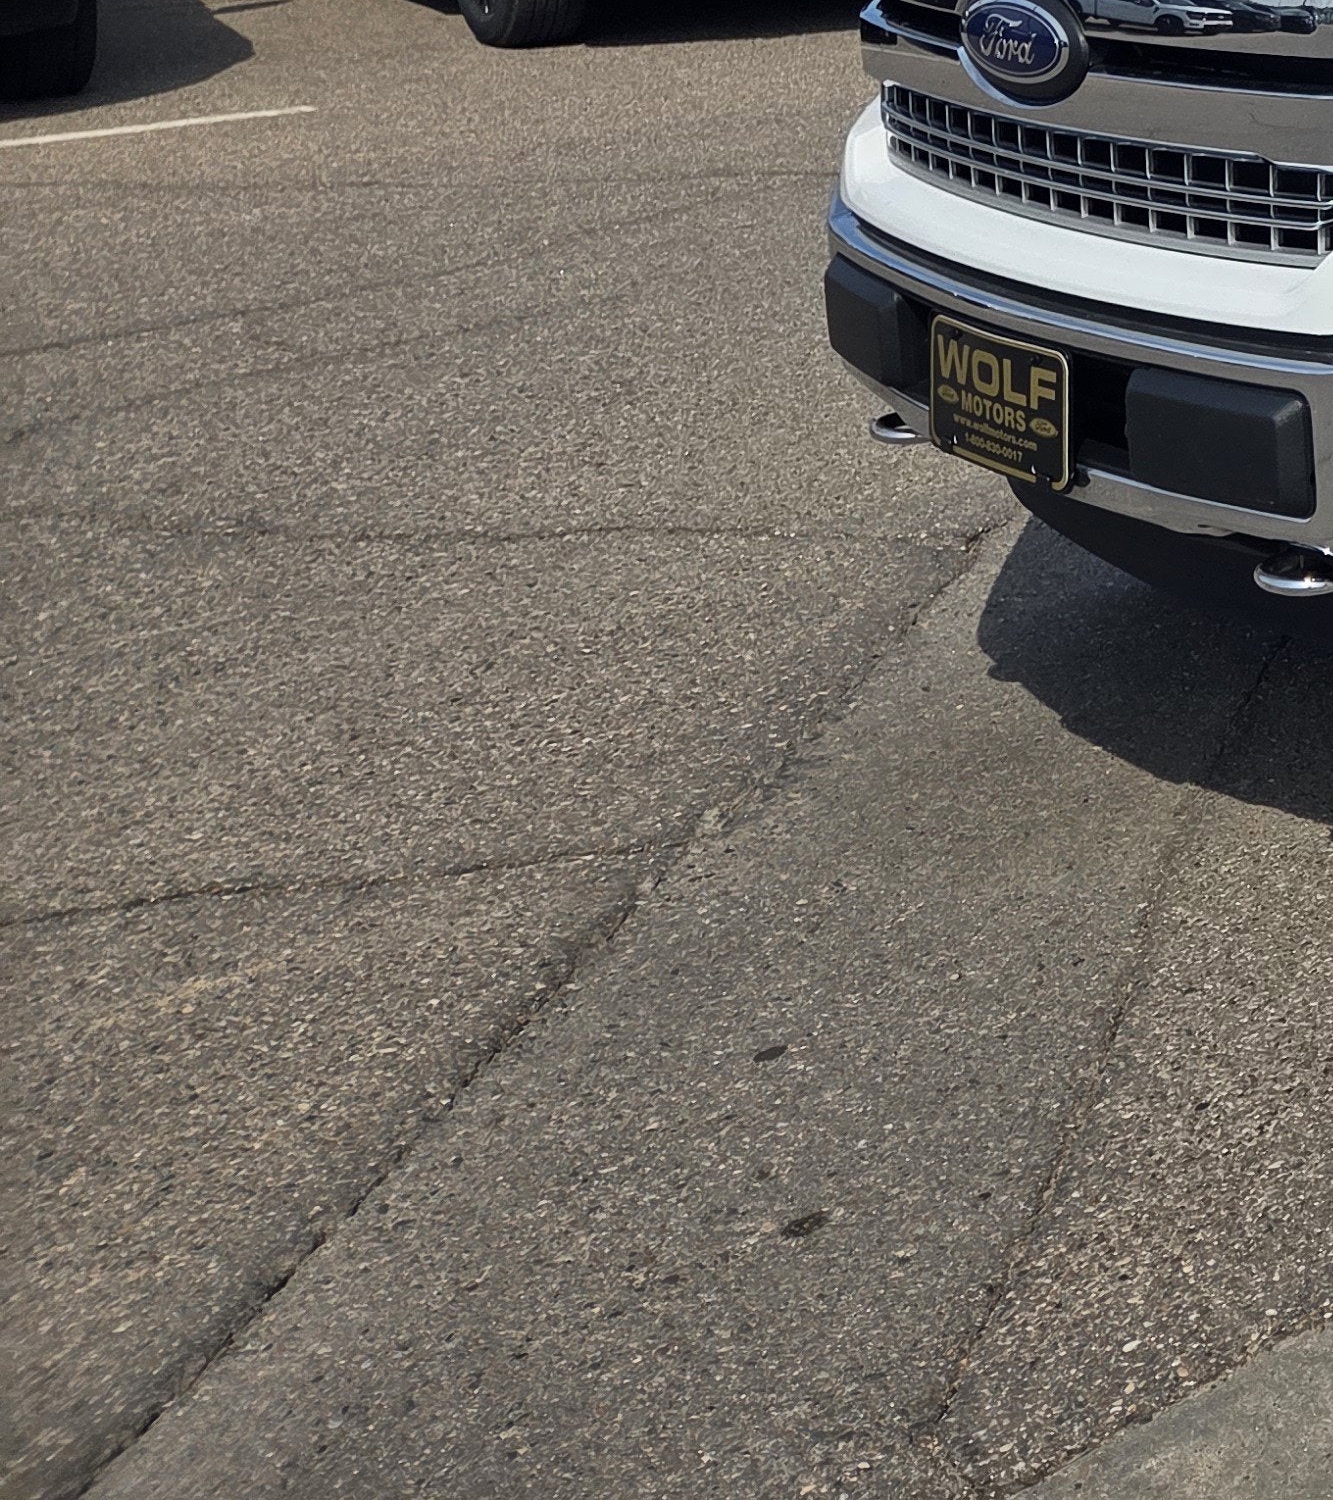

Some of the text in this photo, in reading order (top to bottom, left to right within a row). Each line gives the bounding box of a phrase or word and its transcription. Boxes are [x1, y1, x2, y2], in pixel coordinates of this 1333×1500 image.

[979, 13, 1037, 65] Ford
[937, 334, 1057, 410] WOLF
[961, 390, 1027, 432] MOTORS
